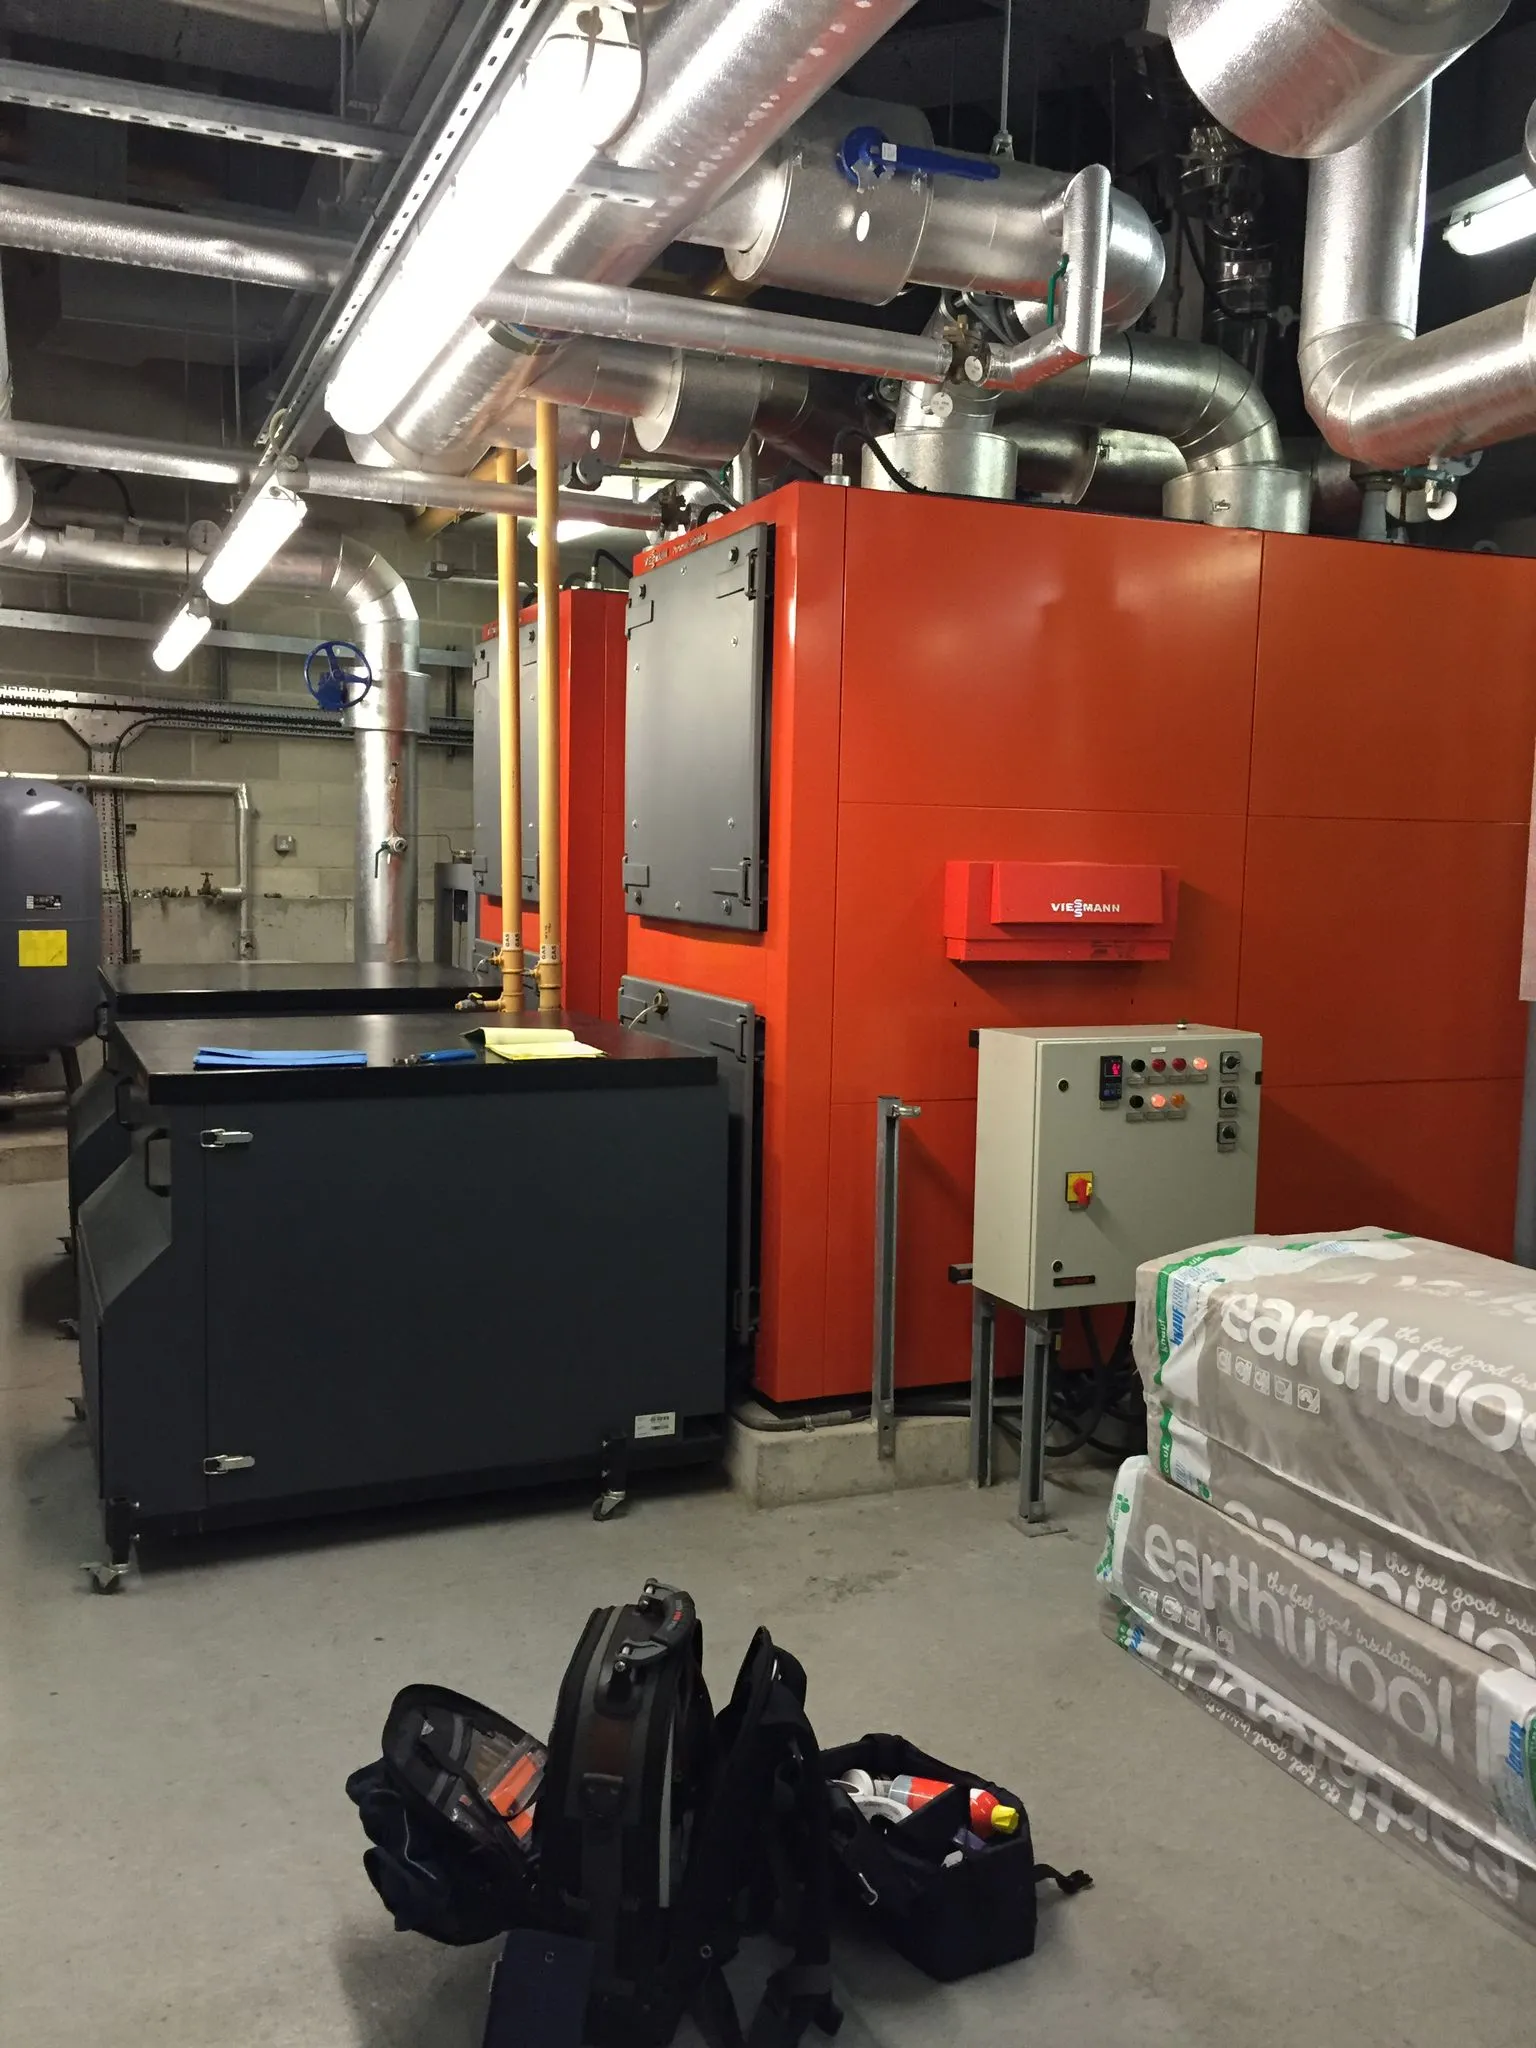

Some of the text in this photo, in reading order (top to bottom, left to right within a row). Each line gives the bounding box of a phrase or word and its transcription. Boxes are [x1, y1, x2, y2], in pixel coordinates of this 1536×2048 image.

[1221, 1292, 1536, 1467] earthwo
[1144, 1523, 1456, 1764] earthwool
[1266, 1571, 1433, 1686] the feel good insulation
[1385, 1551, 1411, 1577] the
[1413, 1563, 1448, 1595] feel
[1452, 1586, 1500, 1618] good
